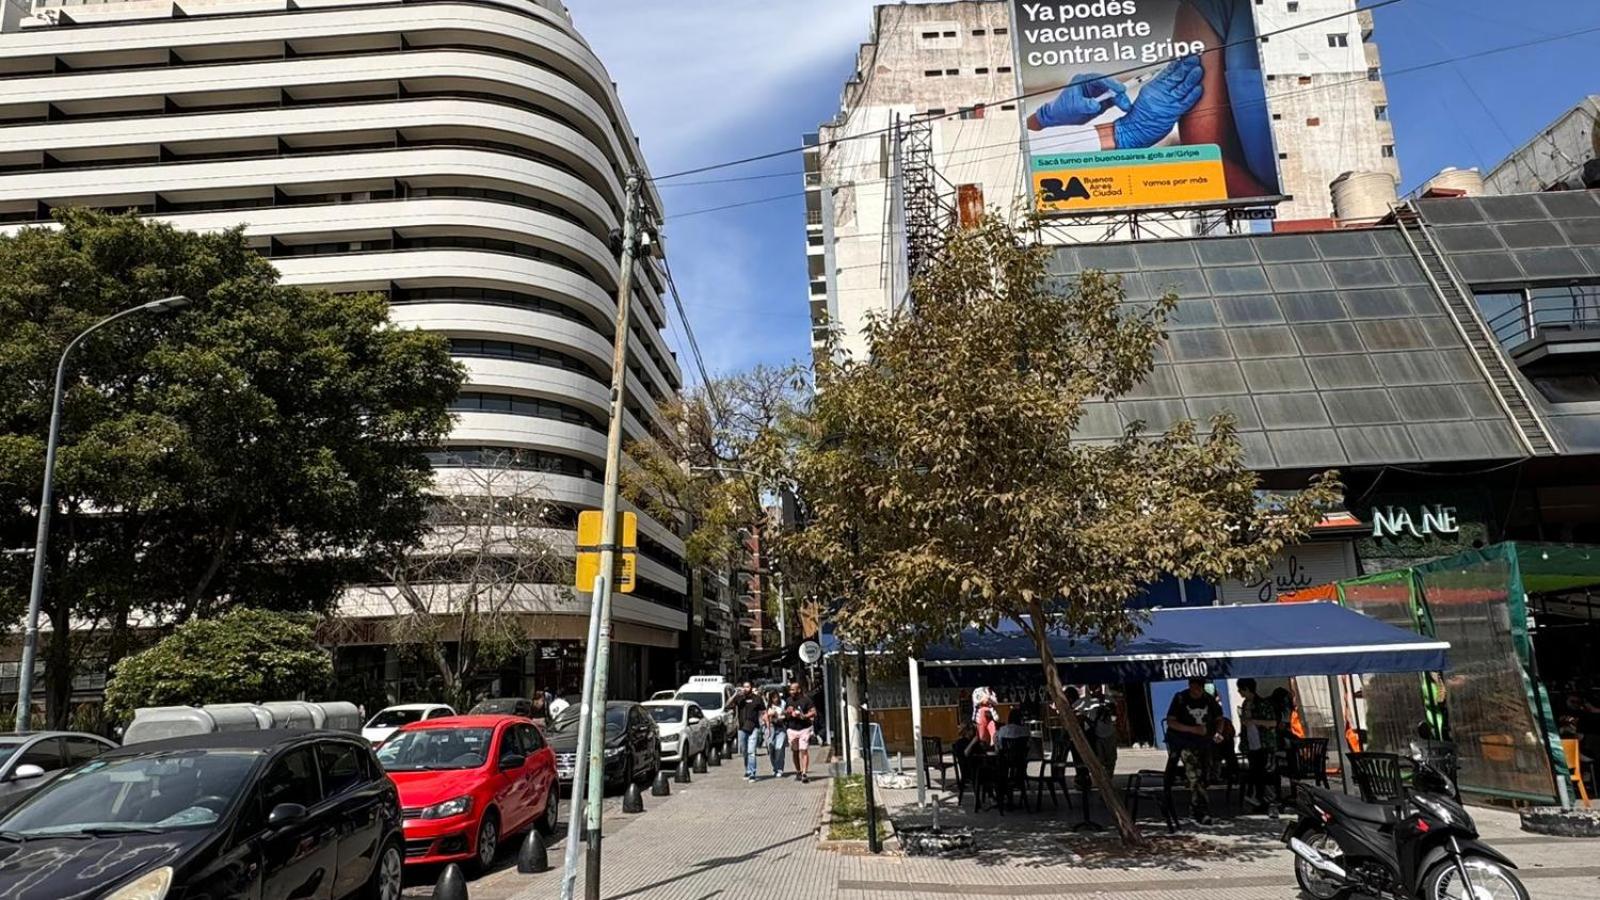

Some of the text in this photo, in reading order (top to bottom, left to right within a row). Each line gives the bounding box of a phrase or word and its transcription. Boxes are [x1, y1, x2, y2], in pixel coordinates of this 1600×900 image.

[1022, 0, 1137, 23] Ya podés
[1024, 19, 1151, 44] vacunarte
[1027, 38, 1206, 67] contra la gripe
[1038, 157, 1059, 167] Sacá
[1060, 156, 1081, 165] turno
[1039, 176, 1091, 202] BA
[1083, 176, 1114, 184] Buenos
[1142, 176, 1208, 188] Vamos por más
[1092, 187, 1123, 197] Ciudad
[1162, 659, 1208, 679] freddo
